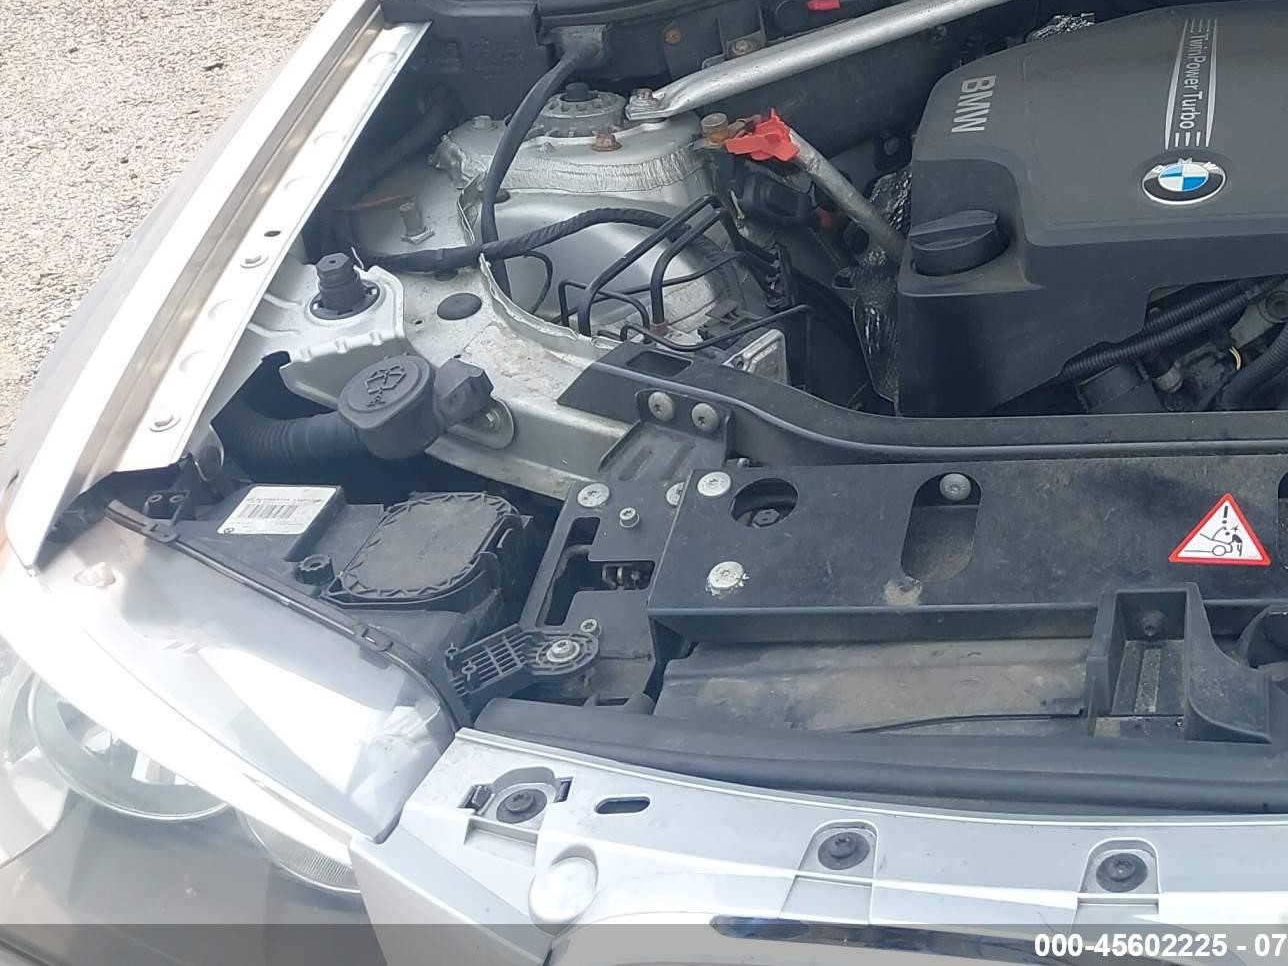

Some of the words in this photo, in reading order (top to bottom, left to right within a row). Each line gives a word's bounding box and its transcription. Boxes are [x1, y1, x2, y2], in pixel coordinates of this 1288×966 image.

[1183, 33, 1209, 90] TwinPower
[951, 74, 997, 133] BMW
[1179, 90, 1204, 130] Turbo
